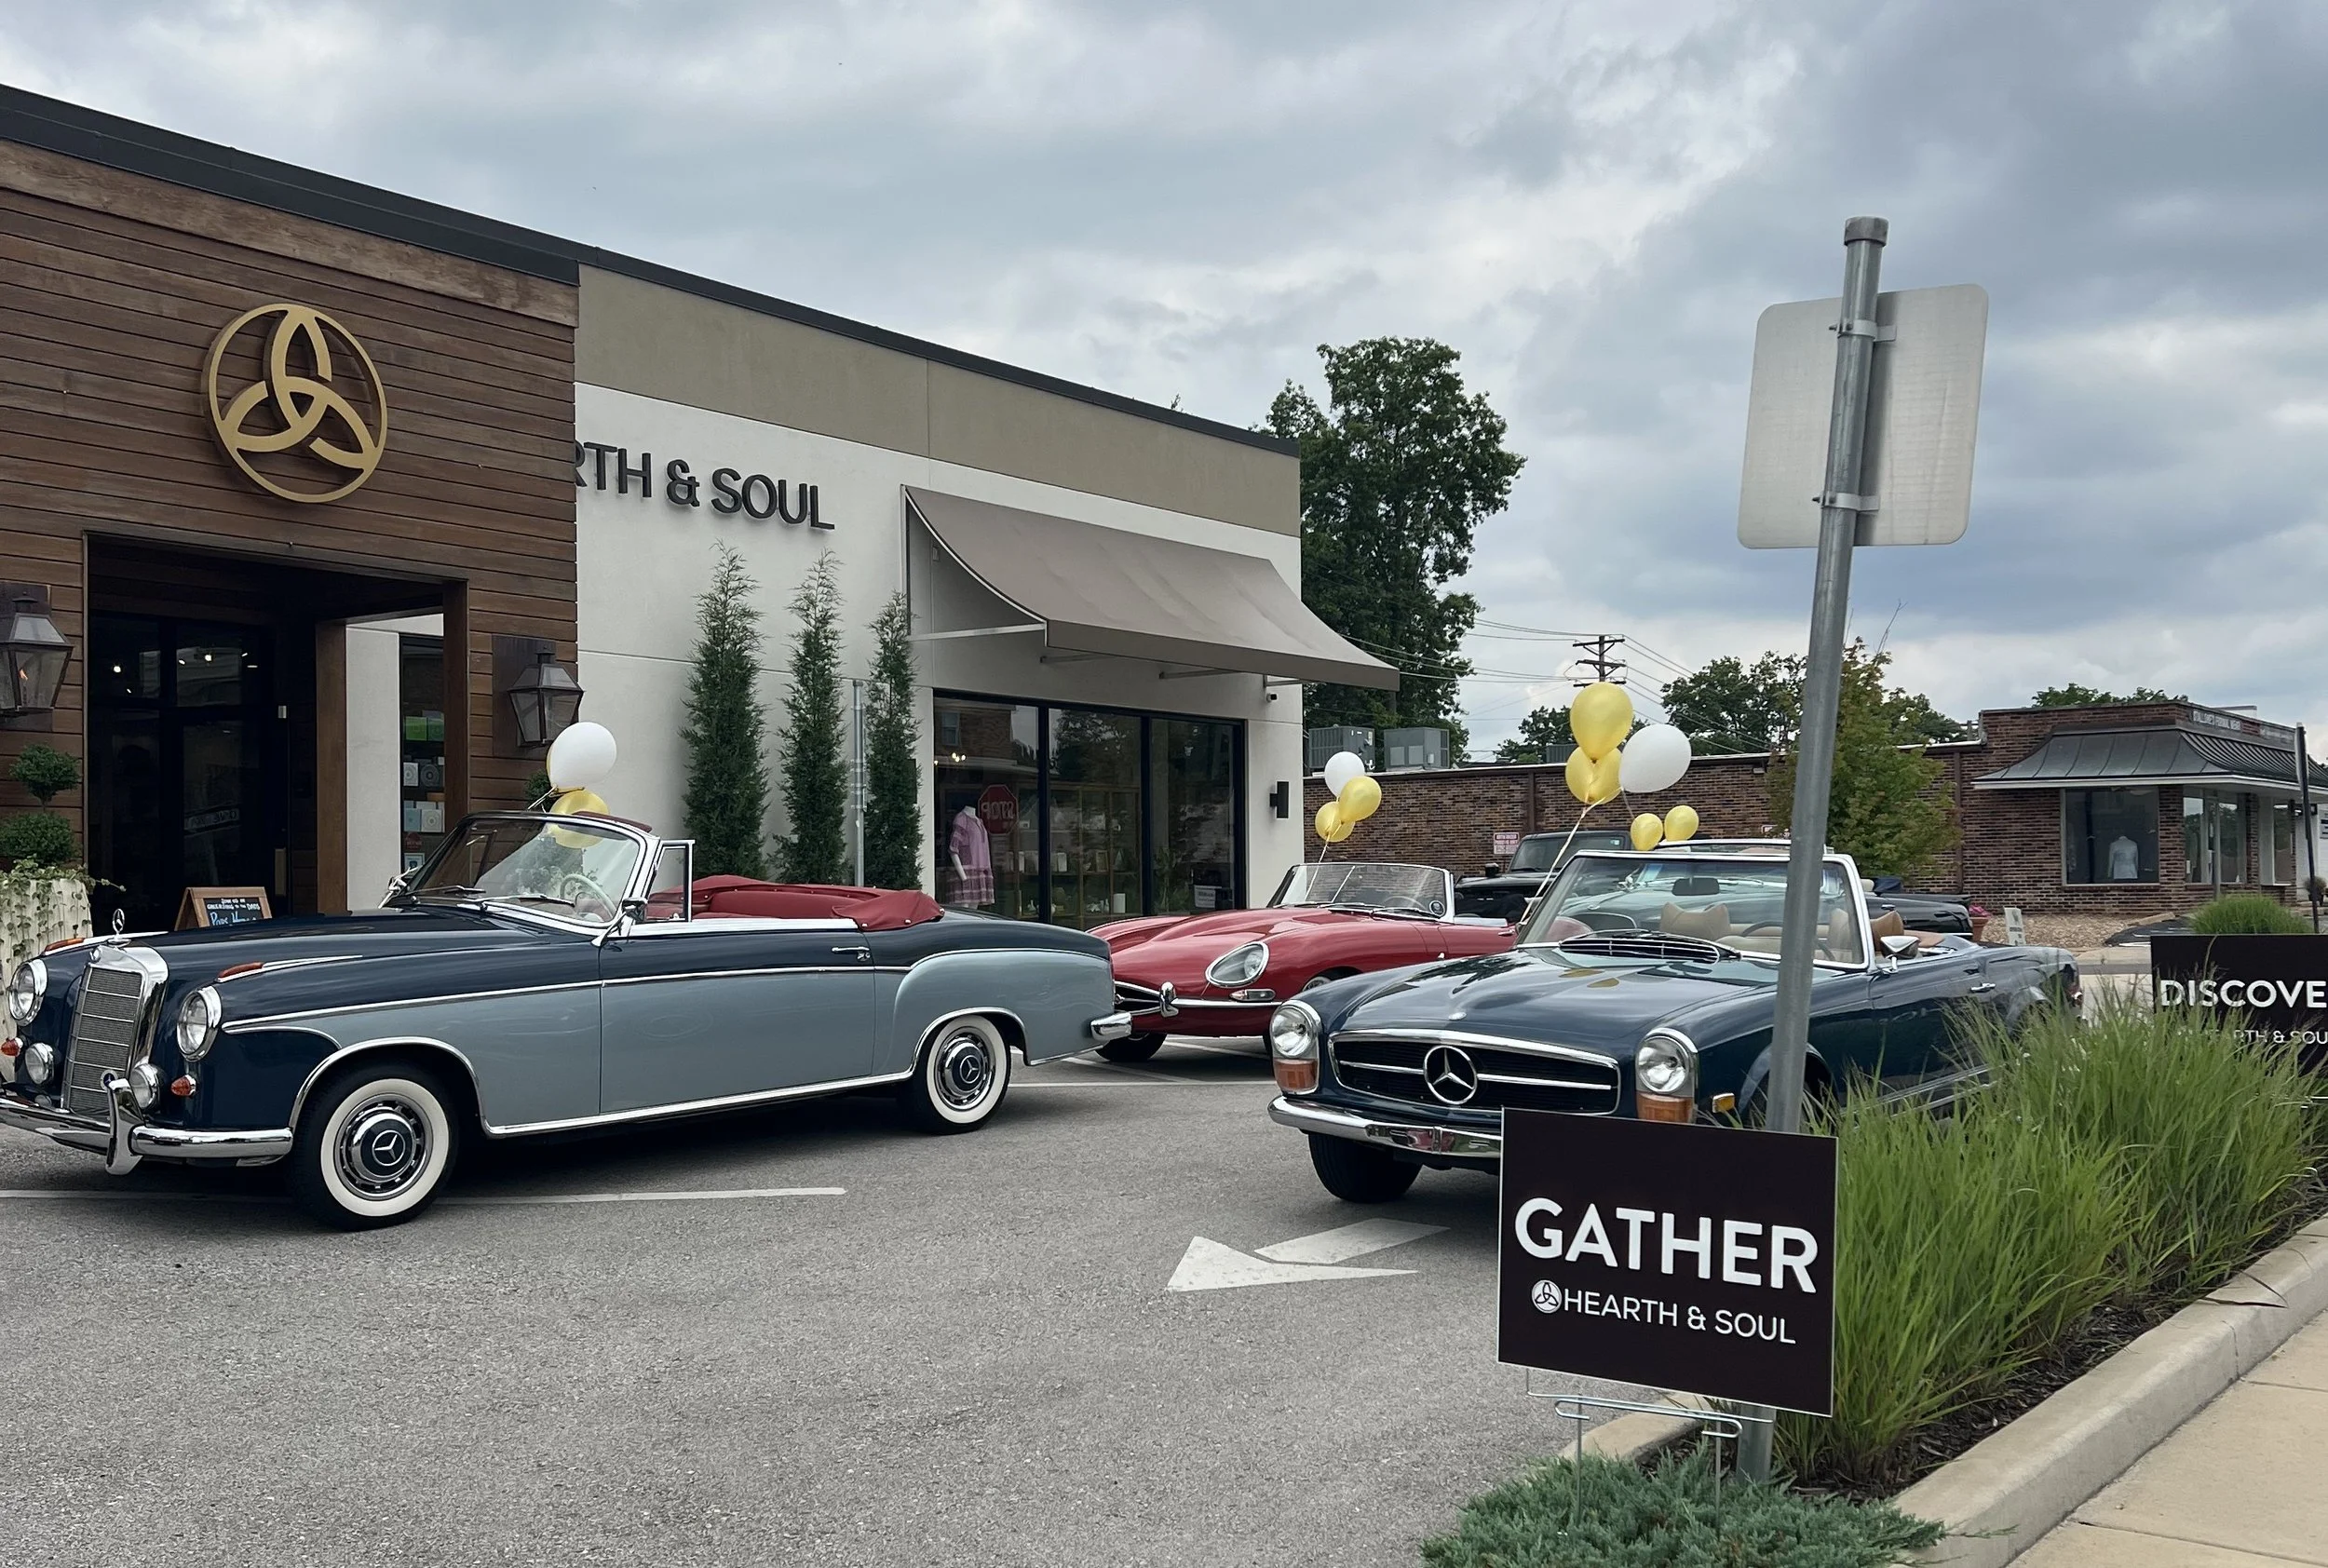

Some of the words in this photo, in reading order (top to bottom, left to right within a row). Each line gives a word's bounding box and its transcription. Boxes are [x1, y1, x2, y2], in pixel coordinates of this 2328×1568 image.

[666, 459, 700, 507] &
[711, 467, 835, 531] SOUL
[2273, 1030, 2285, 1044] &
[1514, 1196, 1819, 1293] GATHER
[1563, 1288, 1677, 1327] HEARTH
[1686, 1305, 1707, 1331] &
[1714, 1309, 1796, 1344] SOUL
